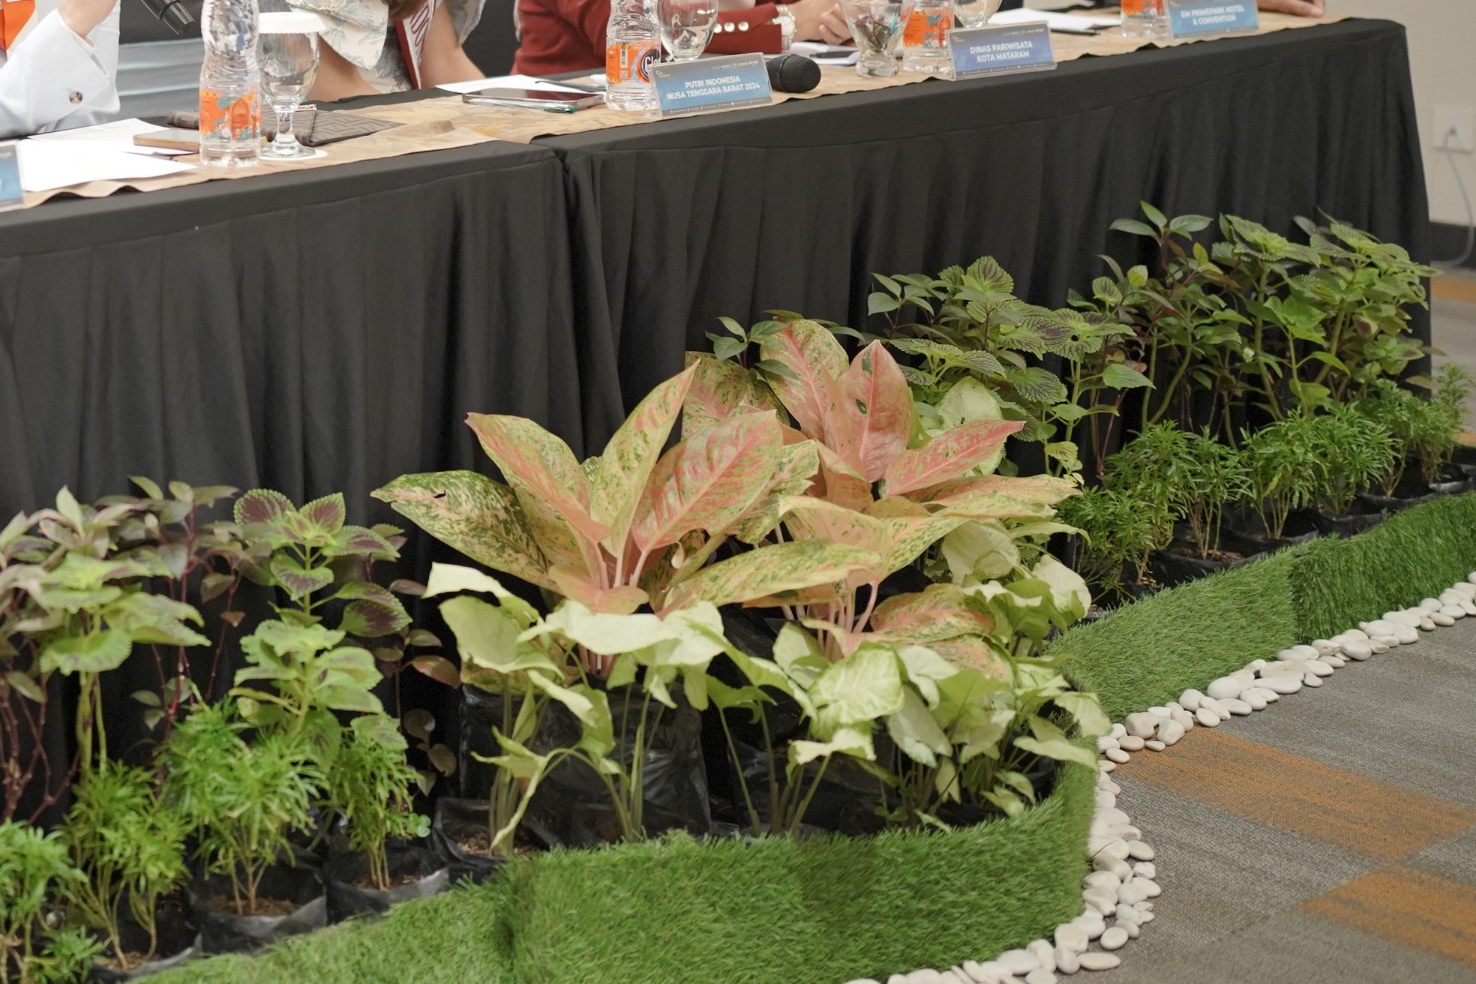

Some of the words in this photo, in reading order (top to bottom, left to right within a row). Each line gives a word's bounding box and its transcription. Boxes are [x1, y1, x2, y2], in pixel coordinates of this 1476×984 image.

[1225, 4, 1245, 13] HOTEL
[970, 44, 991, 54] DINAS
[992, 41, 1033, 52] PARIWISATA
[977, 54, 995, 63] KOTA
[996, 50, 1030, 60] MATARAM
[685, 80, 704, 89] PUTRI
[705, 76, 740, 86] INDONESIA
[667, 92, 686, 100] NUSA
[687, 87, 722, 98] TENGGARA
[723, 84, 744, 93] BARAT
[745, 82, 760, 90] 2024
